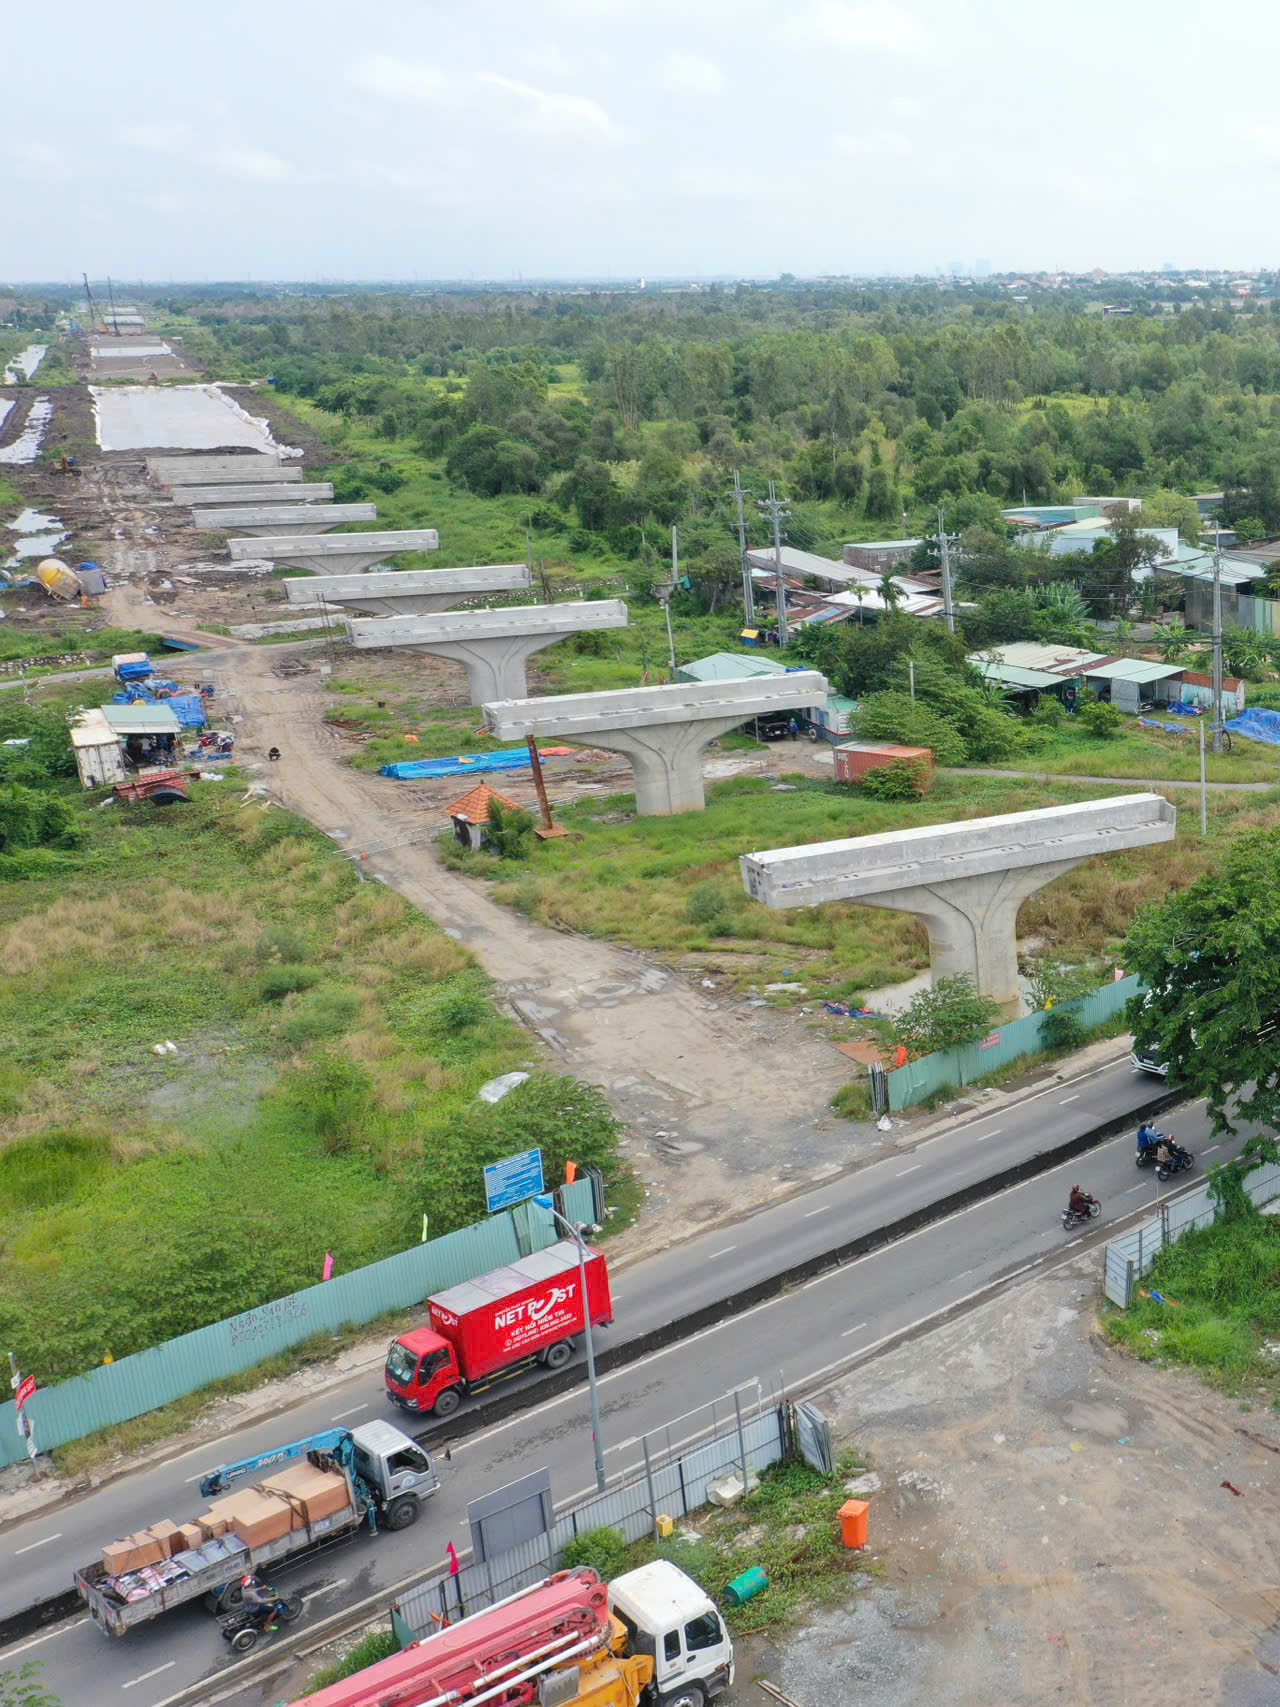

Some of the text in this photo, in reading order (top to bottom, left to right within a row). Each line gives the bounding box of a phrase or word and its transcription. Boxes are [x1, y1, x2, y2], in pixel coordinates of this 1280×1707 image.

[495, 1283, 577, 1330] NET POST
[554, 1309, 565, 1318] TIN
